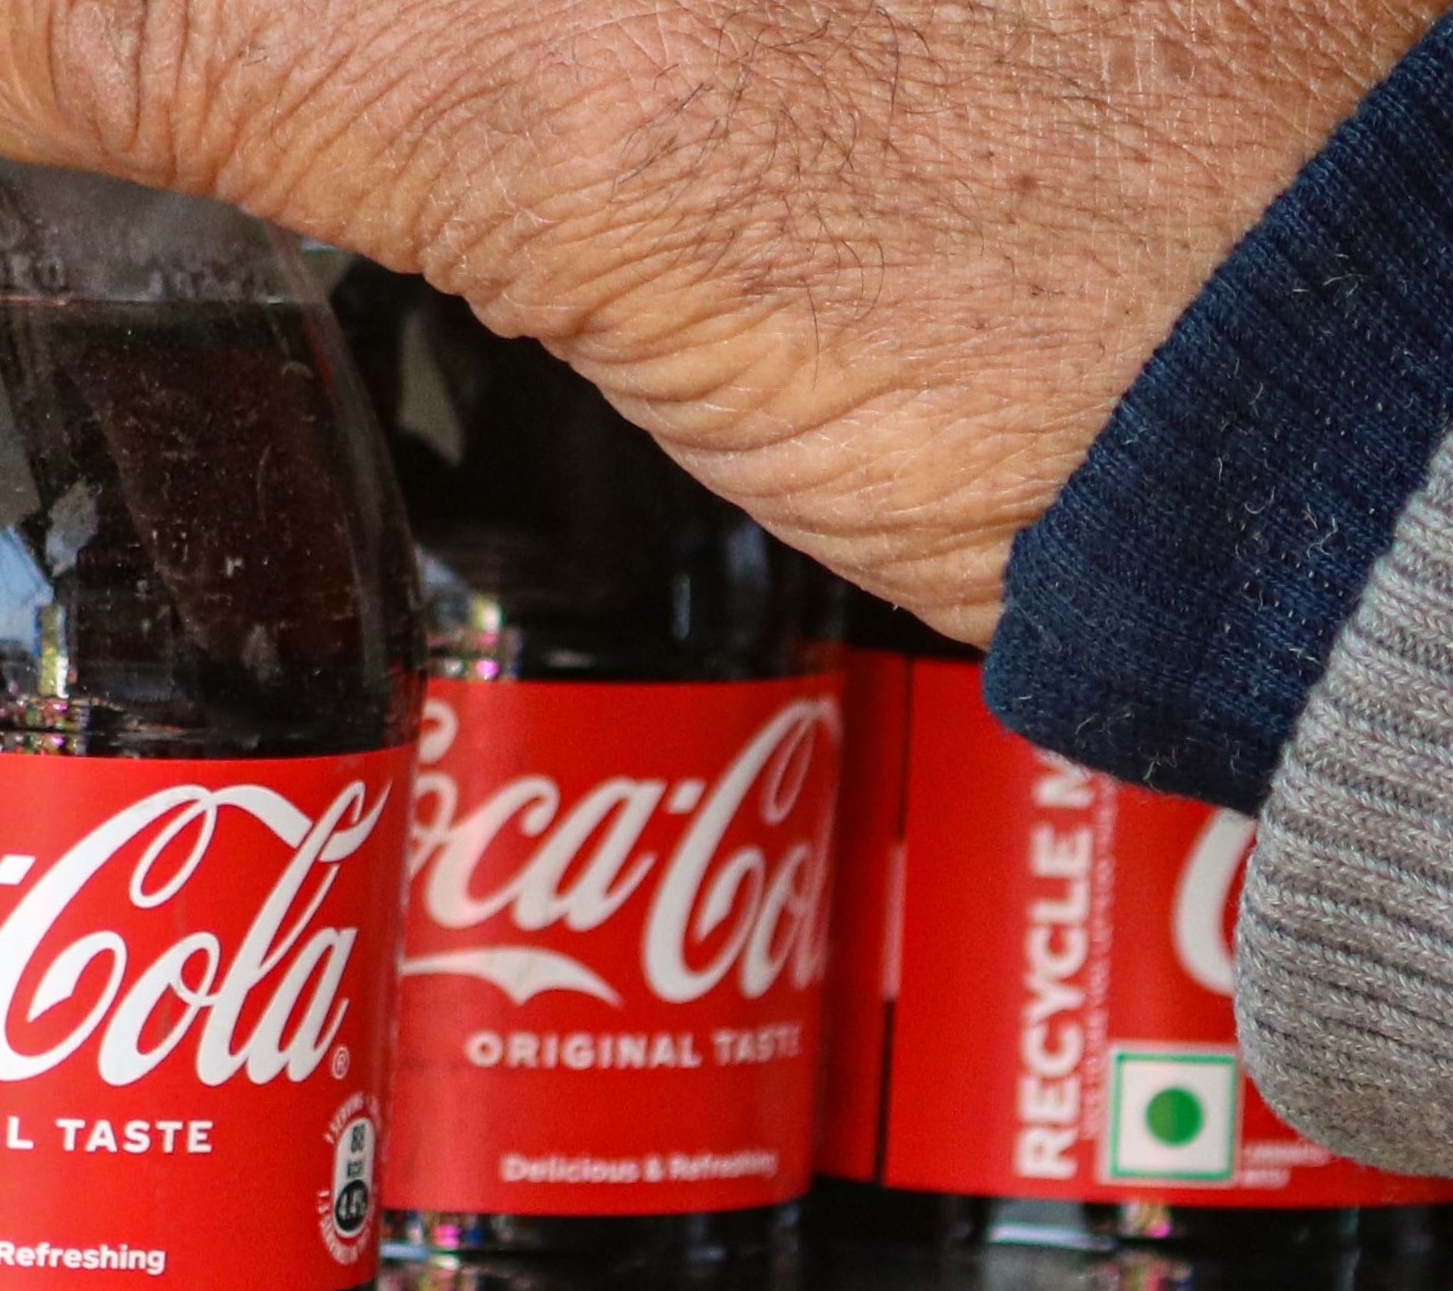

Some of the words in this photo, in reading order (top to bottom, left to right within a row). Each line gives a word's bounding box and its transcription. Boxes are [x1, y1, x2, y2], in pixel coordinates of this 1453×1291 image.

[1017, 826, 1093, 1180] RECYCLE
[466, 1031, 702, 1070] ORIGINAL
[56, 1118, 214, 1153] TASTE
[501, 1153, 640, 1183] Delicious
